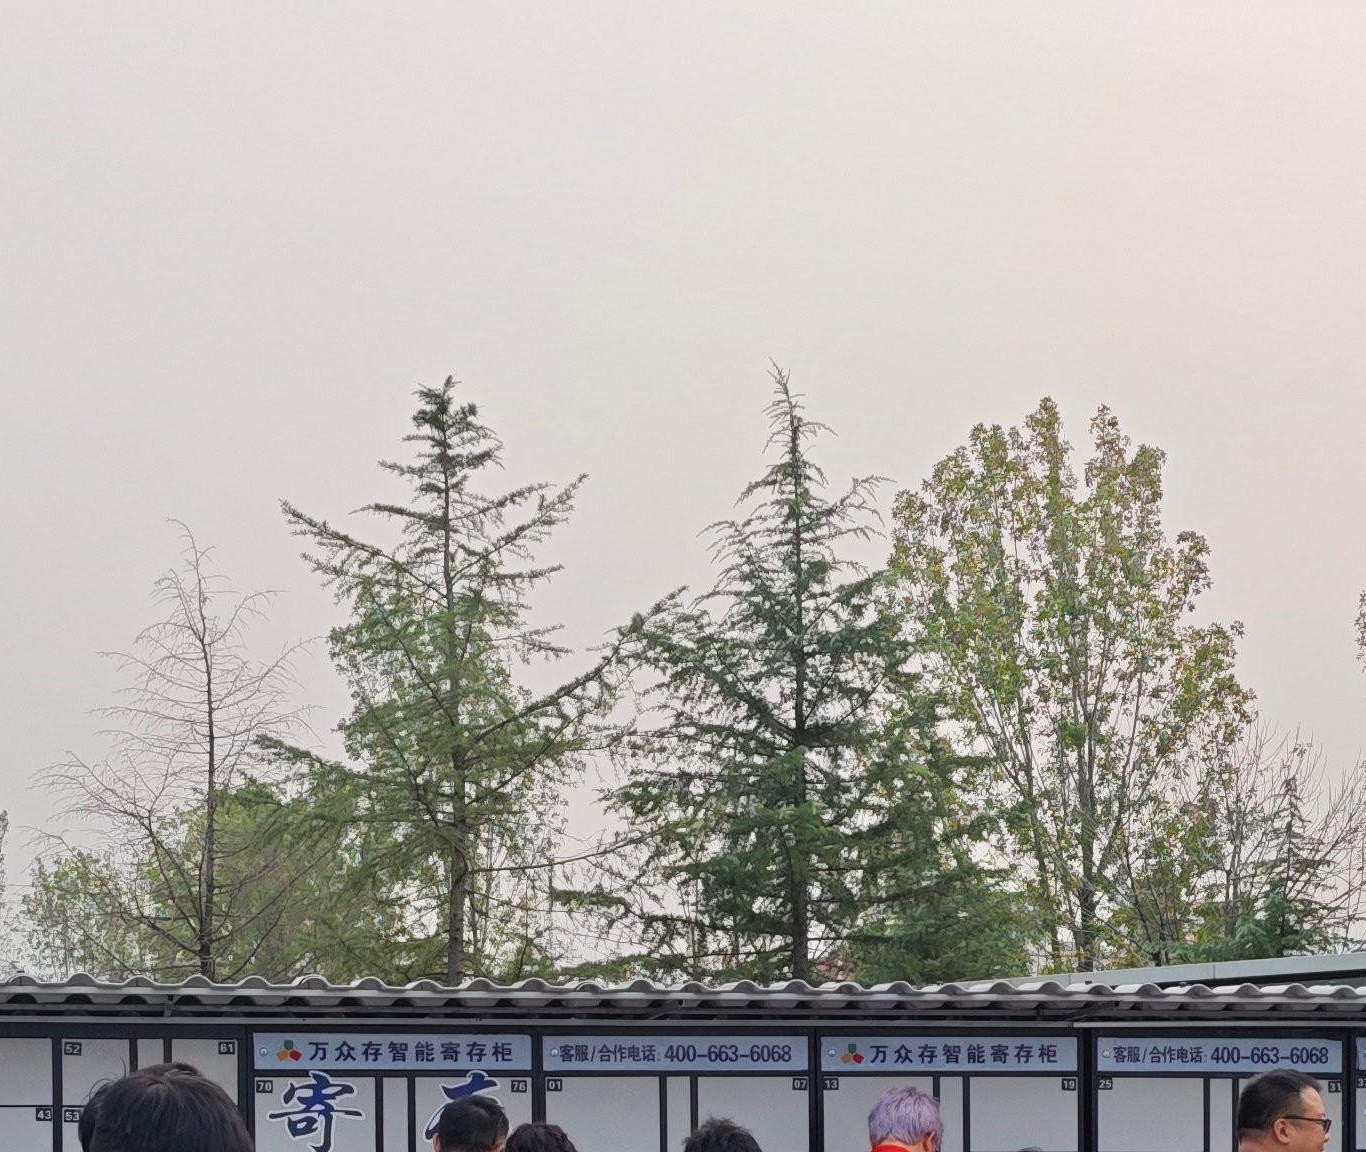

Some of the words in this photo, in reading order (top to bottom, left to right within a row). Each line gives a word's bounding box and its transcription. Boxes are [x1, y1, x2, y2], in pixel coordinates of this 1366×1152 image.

[65, 1043, 81, 1054] 52
[220, 1043, 234, 1053] 61
[307, 1040, 514, 1063] 万众存智能寄存柜
[664, 1044, 792, 1063] 400-663-6068
[869, 1043, 1058, 1064] 万众存智能寄存柜
[1210, 1046, 1329, 1065] 400-663-6068
[257, 1081, 272, 1092] 70
[512, 1081, 526, 1091] 76
[548, 1080, 561, 1090] 01
[793, 1079, 807, 1089] 07
[825, 1079, 838, 1089] 13
[1063, 1080, 1075, 1090] 19
[1098, 1079, 1112, 1089] 25
[1329, 1082, 1342, 1092] 31
[37, 1109, 52, 1120] 43
[65, 1111, 80, 1121] 53
